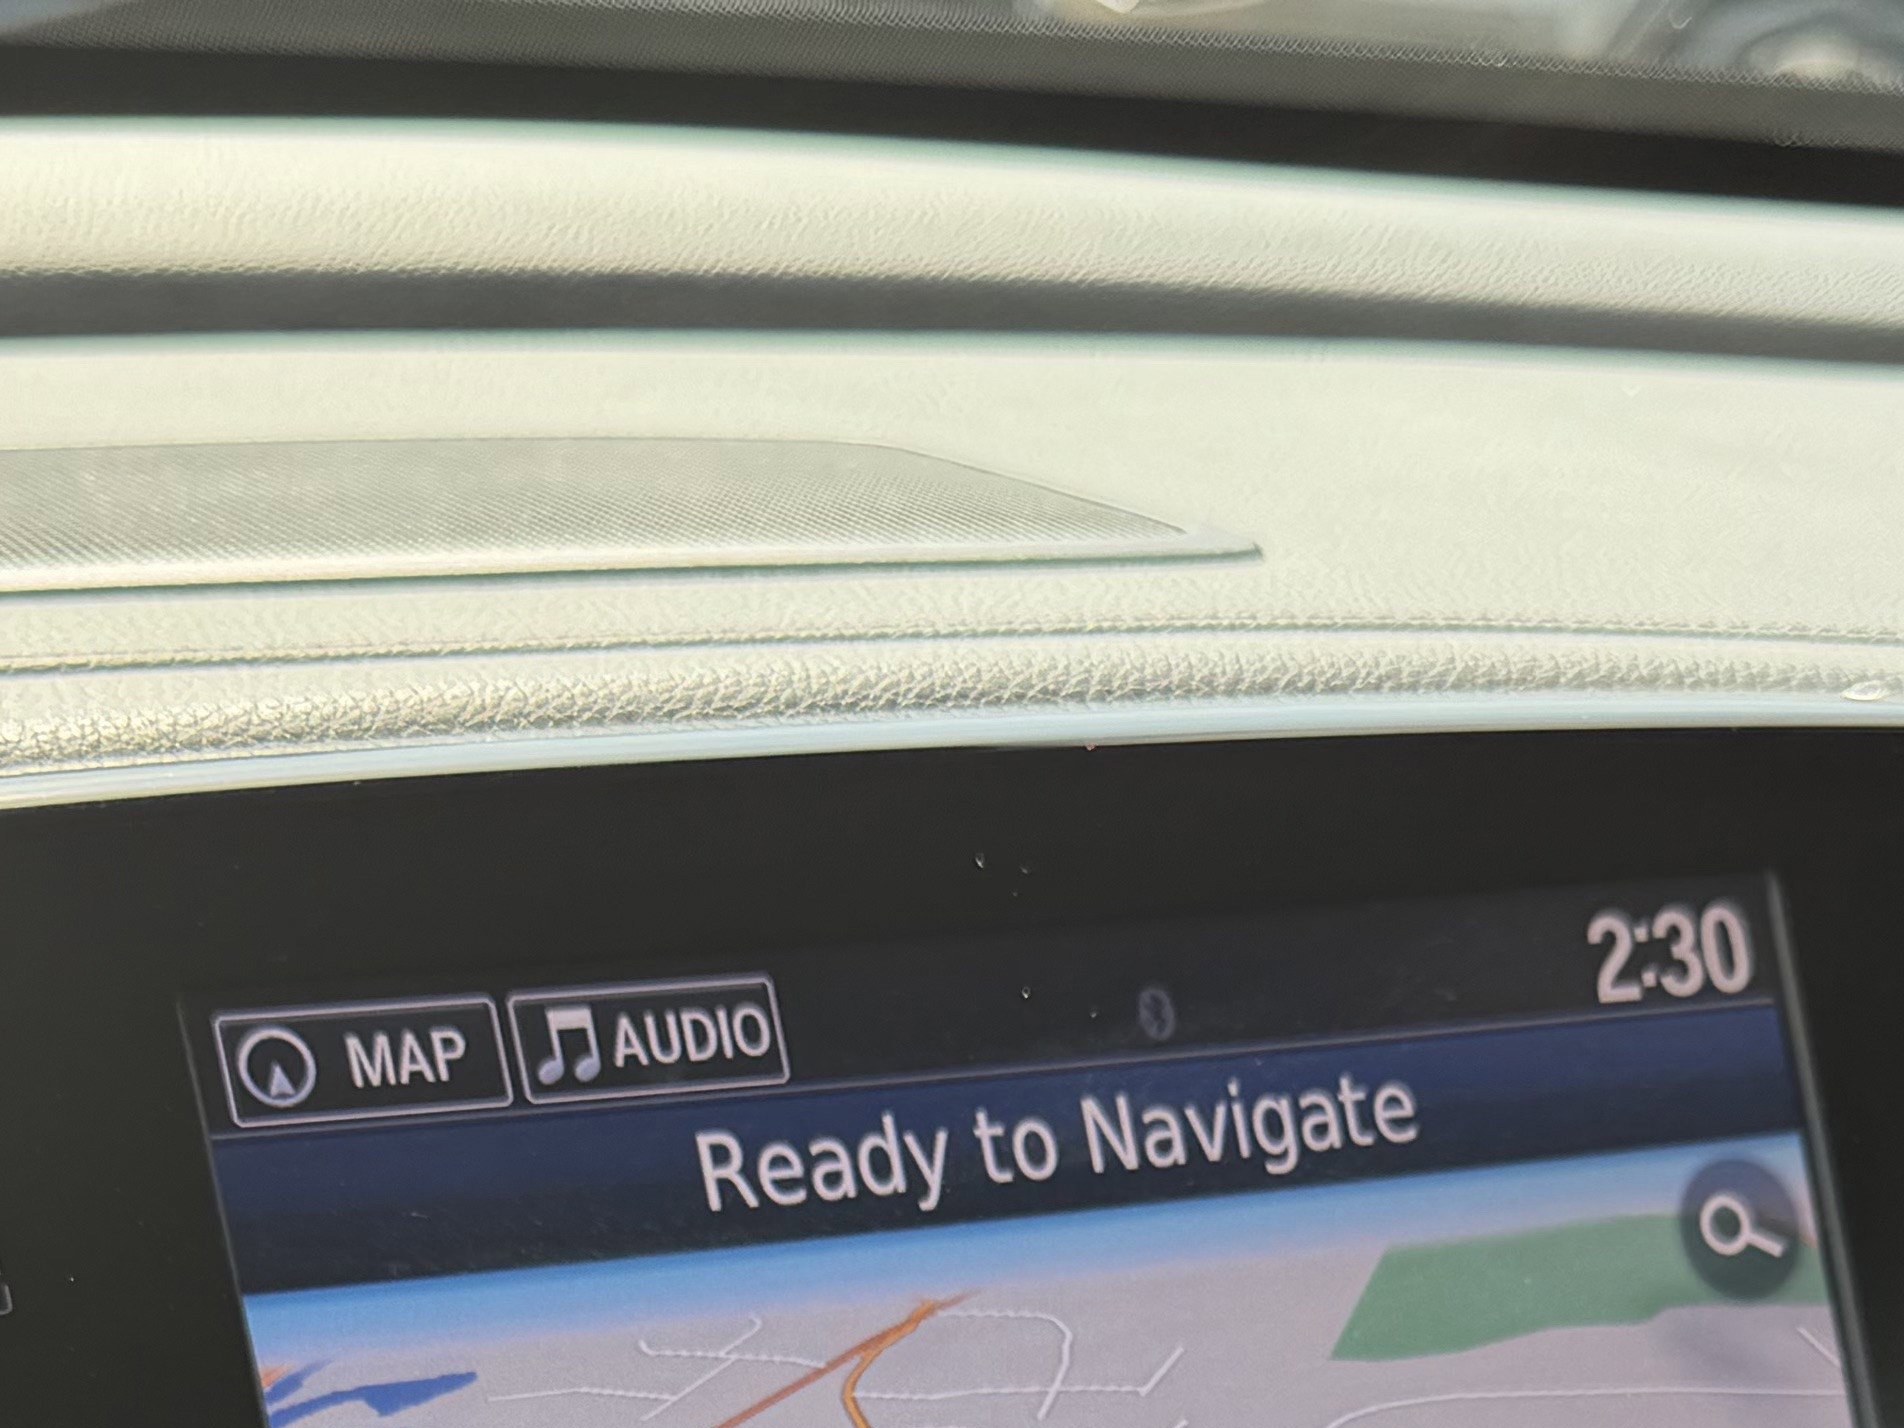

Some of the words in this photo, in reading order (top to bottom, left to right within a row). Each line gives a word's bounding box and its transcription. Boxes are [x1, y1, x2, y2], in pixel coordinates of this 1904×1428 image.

[1586, 897, 1754, 1004] 2:30
[344, 1026, 468, 1090] MAP
[613, 1002, 772, 1069] AUDIO
[696, 1109, 949, 1213] Ready
[975, 1108, 1059, 1184] to
[1081, 1072, 1420, 1176] Navigate
